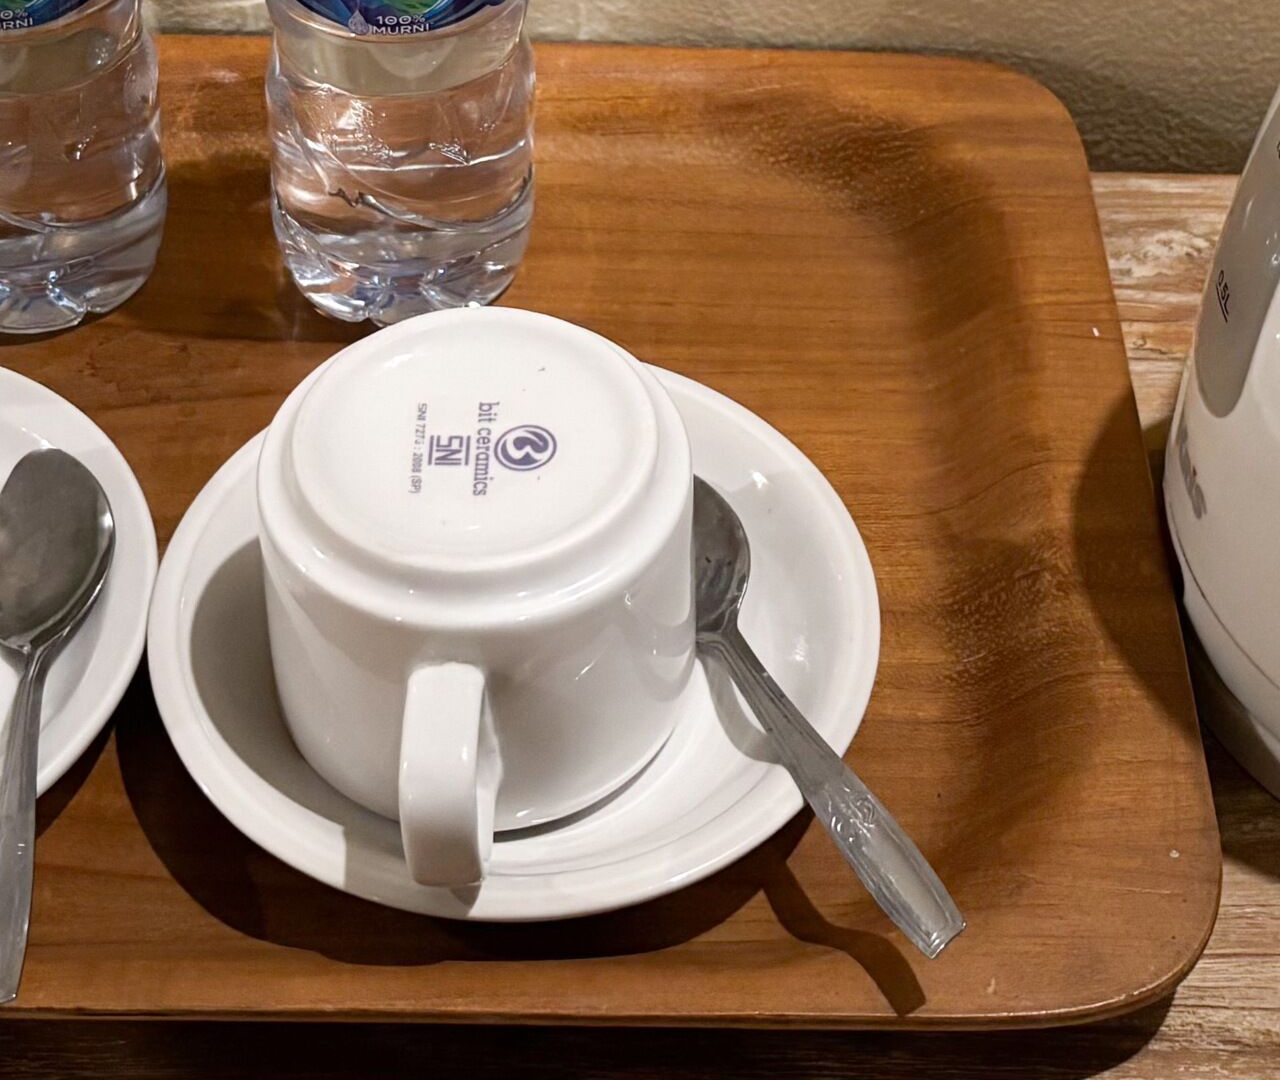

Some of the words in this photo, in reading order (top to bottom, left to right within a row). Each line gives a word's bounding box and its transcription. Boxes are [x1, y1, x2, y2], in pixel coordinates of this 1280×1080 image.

[371, 23, 431, 36] MURNI
[375, 15, 426, 26] 100%
[417, 403, 427, 421] SNI
[478, 402, 500, 423] bit
[433, 434, 465, 466] SNI
[411, 452, 423, 473] 2008
[473, 427, 494, 496] ceramics
[408, 475, 422, 494] (SP)
